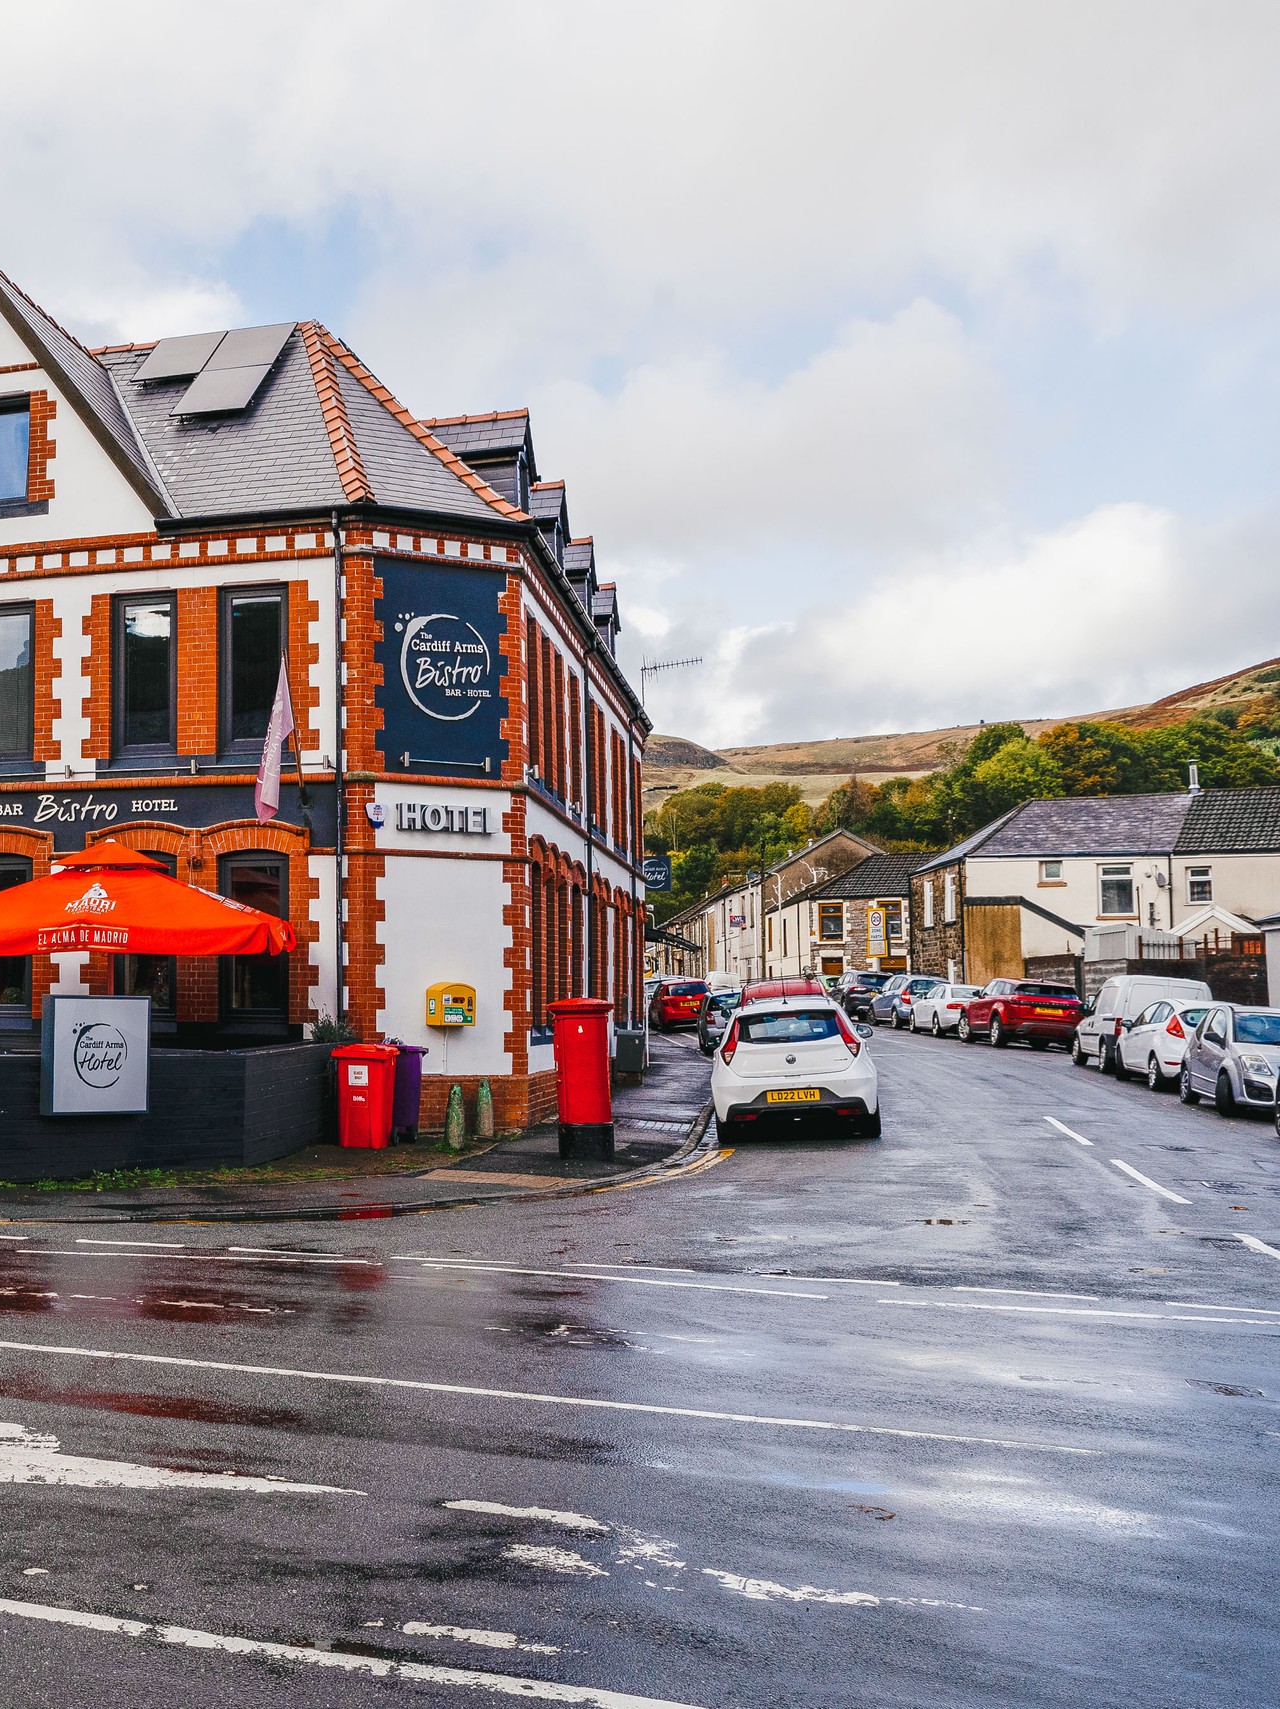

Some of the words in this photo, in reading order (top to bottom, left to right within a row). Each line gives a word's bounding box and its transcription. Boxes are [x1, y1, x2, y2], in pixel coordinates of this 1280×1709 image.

[411, 639, 451, 652] Cardiff
[454, 641, 484, 653] Arms
[415, 655, 483, 689] Bistro
[445, 689, 462, 697] BAR
[467, 689, 492, 698] HOTEL
[33, 794, 118, 823] Bistro
[131, 800, 178, 812] HOTEL
[399, 802, 501, 833] HOTEL
[38, 933, 47, 945] EL
[51, 930, 76, 944] ALMA
[80, 930, 90, 942] DE
[94, 930, 129, 944] MADRID
[80, 1040, 104, 1048] Cardiff
[78, 1051, 122, 1071] Hotel
[771, 1092, 795, 1101] LD22
[797, 1090, 816, 1100] LVH
